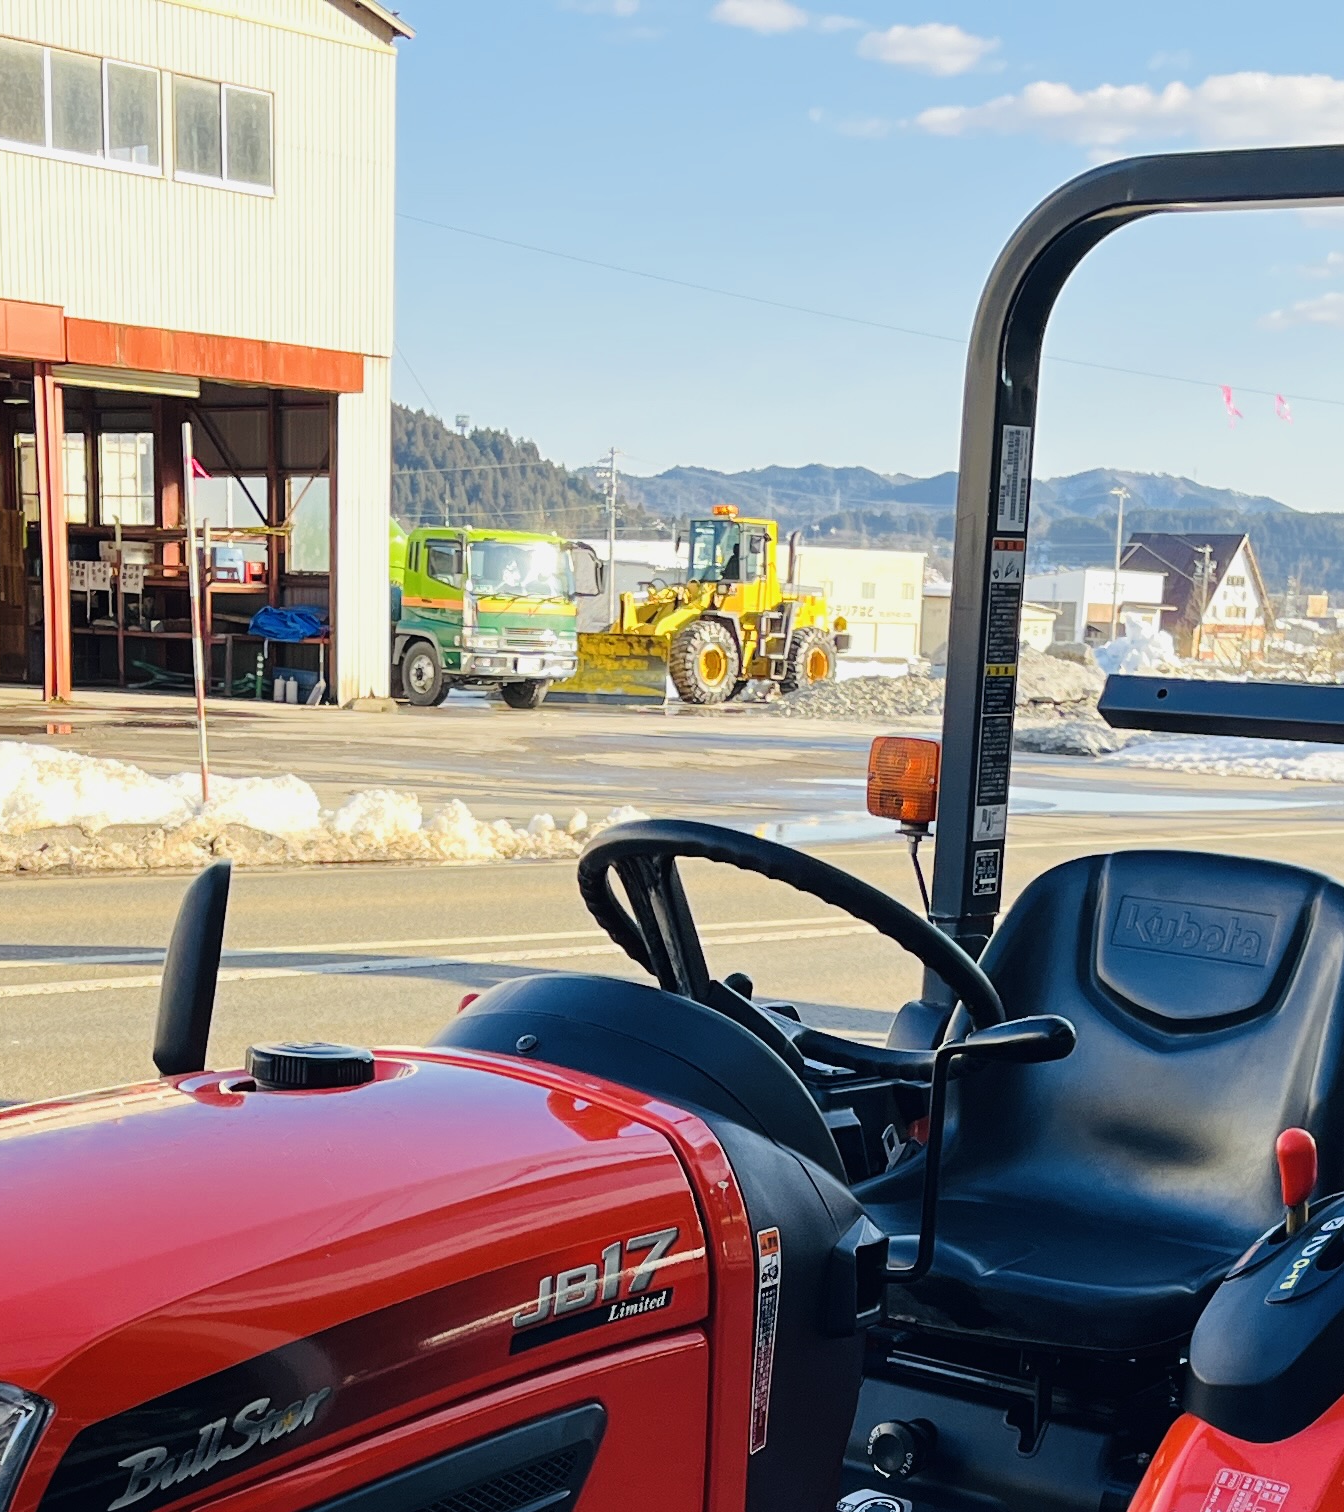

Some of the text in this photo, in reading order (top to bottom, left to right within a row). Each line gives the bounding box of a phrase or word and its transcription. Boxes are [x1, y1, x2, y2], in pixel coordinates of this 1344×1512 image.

[1125, 904, 1262, 958] Kubota
[513, 1227, 678, 1328] JB17
[608, 1291, 667, 1322] Limited
[899, 1452, 913, 1475] OPEN
